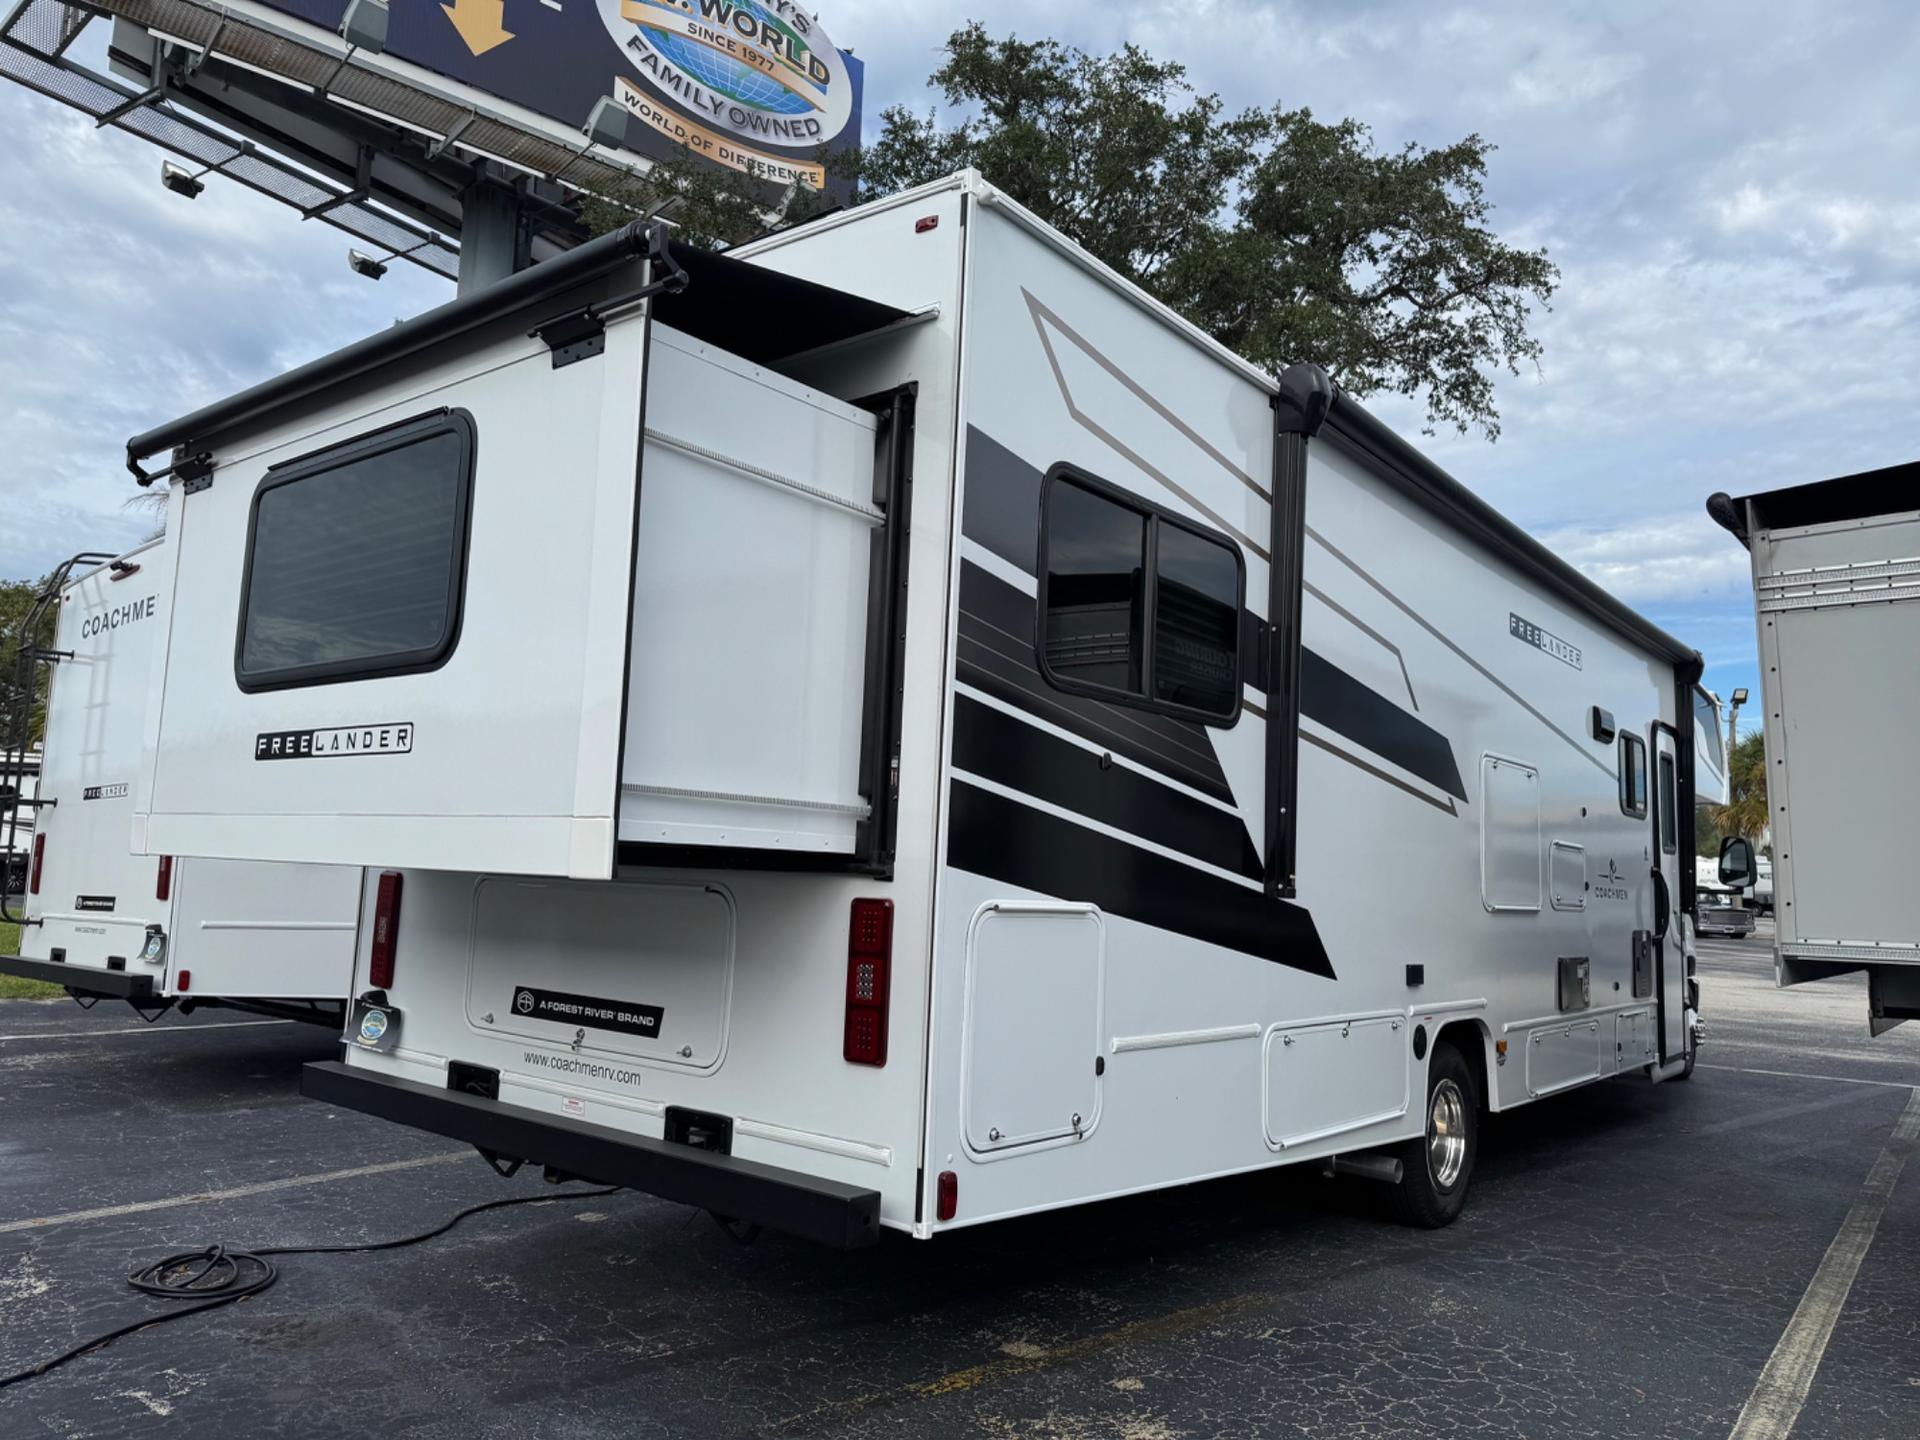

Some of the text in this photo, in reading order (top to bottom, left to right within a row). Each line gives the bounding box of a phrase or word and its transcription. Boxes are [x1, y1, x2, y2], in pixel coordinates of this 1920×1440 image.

[687, 22, 775, 71] SINCE 1977
[700, 0, 831, 85] WORLD
[626, 34, 821, 138] FAMILY OWNED
[624, 90, 686, 138] WORLD
[690, 134, 714, 151] OF
[82, 593, 160, 639] COACHME
[256, 728, 409, 757] FREELANDER
[539, 1000, 547, 1009] A
[547, 1001, 584, 1015] FOREST
[617, 1012, 655, 1027] BRAND
[524, 1051, 641, 1086] www.coachmenrv.com
